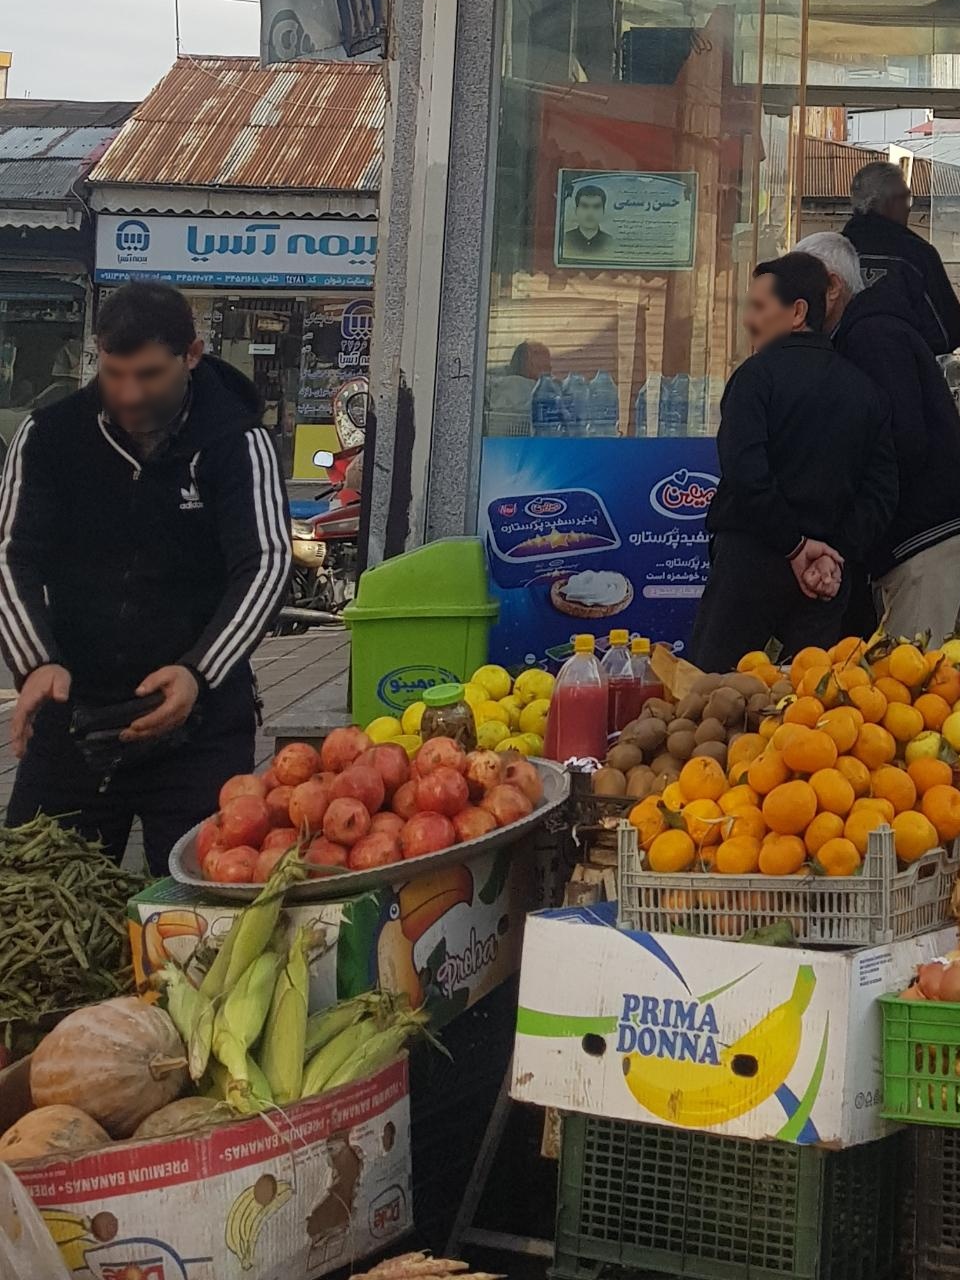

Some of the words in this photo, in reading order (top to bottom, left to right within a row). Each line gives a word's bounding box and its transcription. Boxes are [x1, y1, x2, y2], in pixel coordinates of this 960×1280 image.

[186, 223, 281, 263] آسیا
[621, 993, 719, 1036] PRIMA
[615, 1022, 722, 1067] DONNA
[64, 1170, 126, 1196] BANANAS
[129, 1159, 189, 1184] PREMIUM
